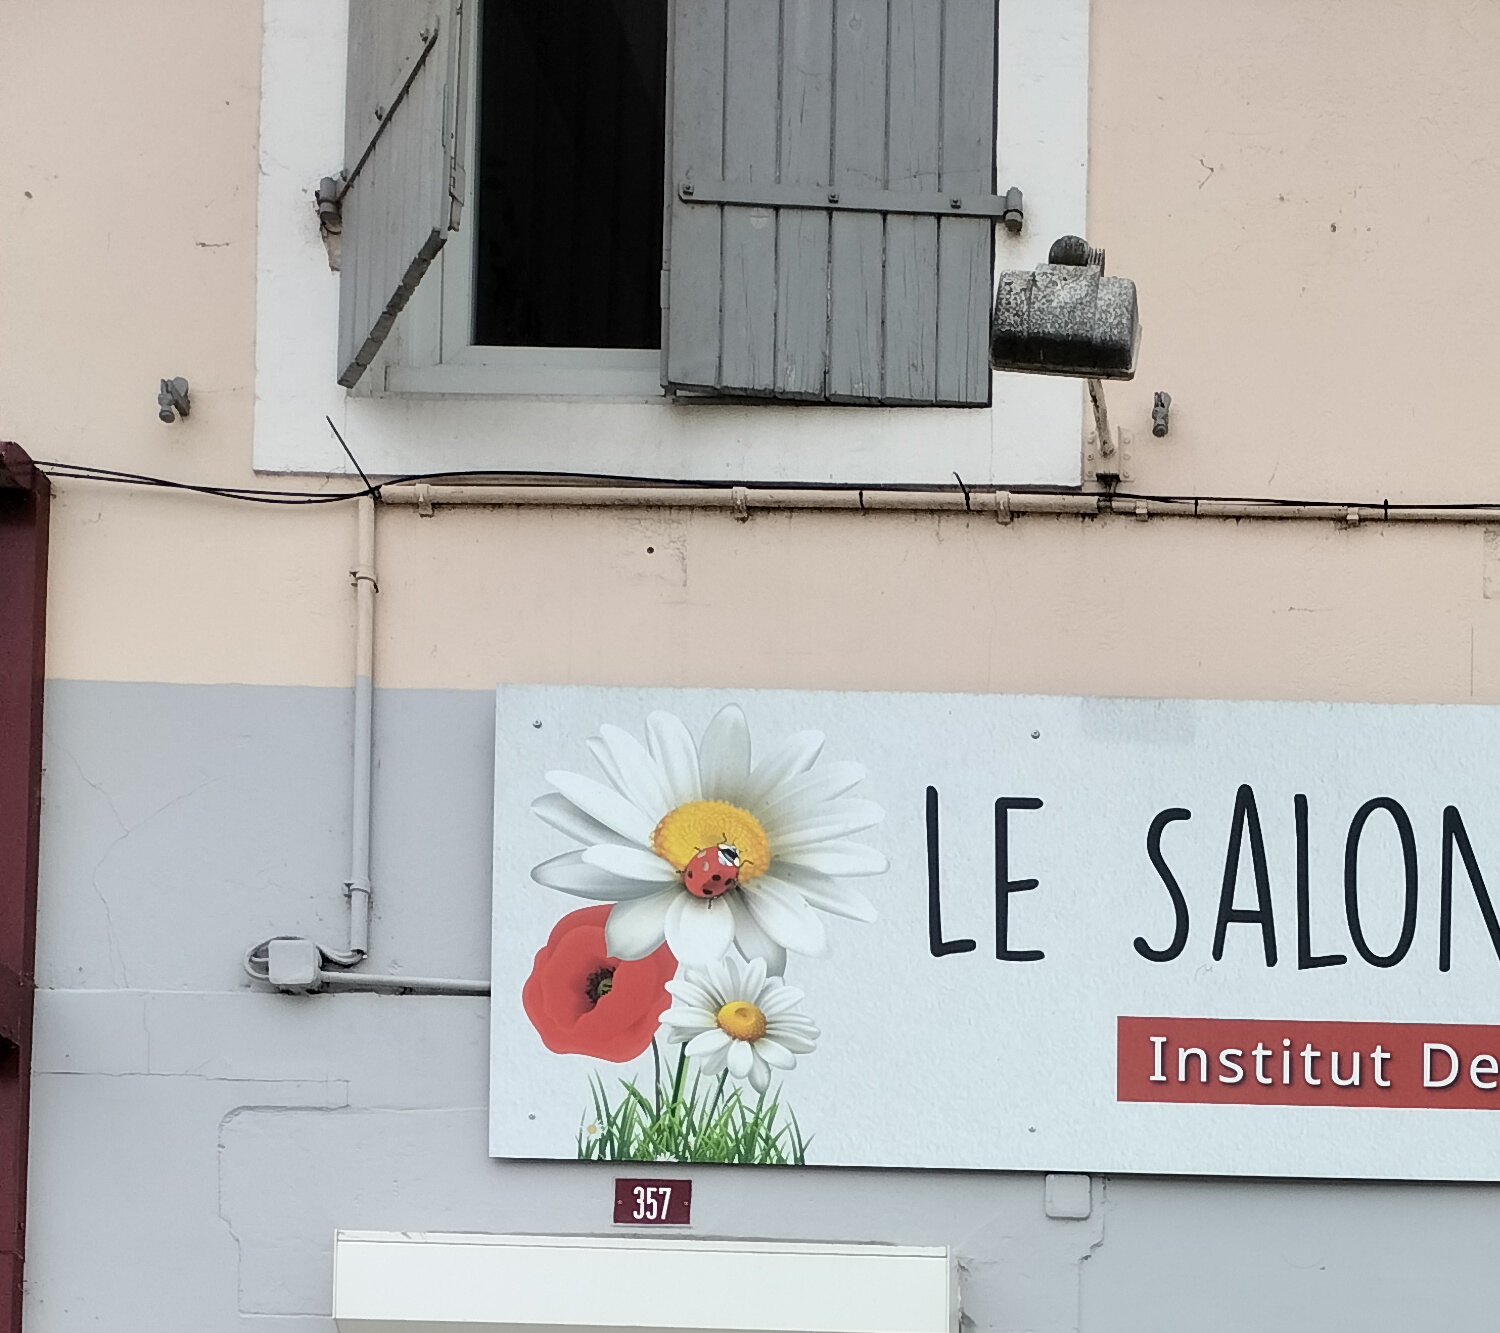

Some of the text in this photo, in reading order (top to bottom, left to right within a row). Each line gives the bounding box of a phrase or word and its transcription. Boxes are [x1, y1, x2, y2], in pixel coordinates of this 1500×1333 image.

[926, 785, 1046, 961] LE
[1149, 1035, 1392, 1089] Institut
[1421, 1042, 1500, 1091] De
[632, 1186, 672, 1222] 357
